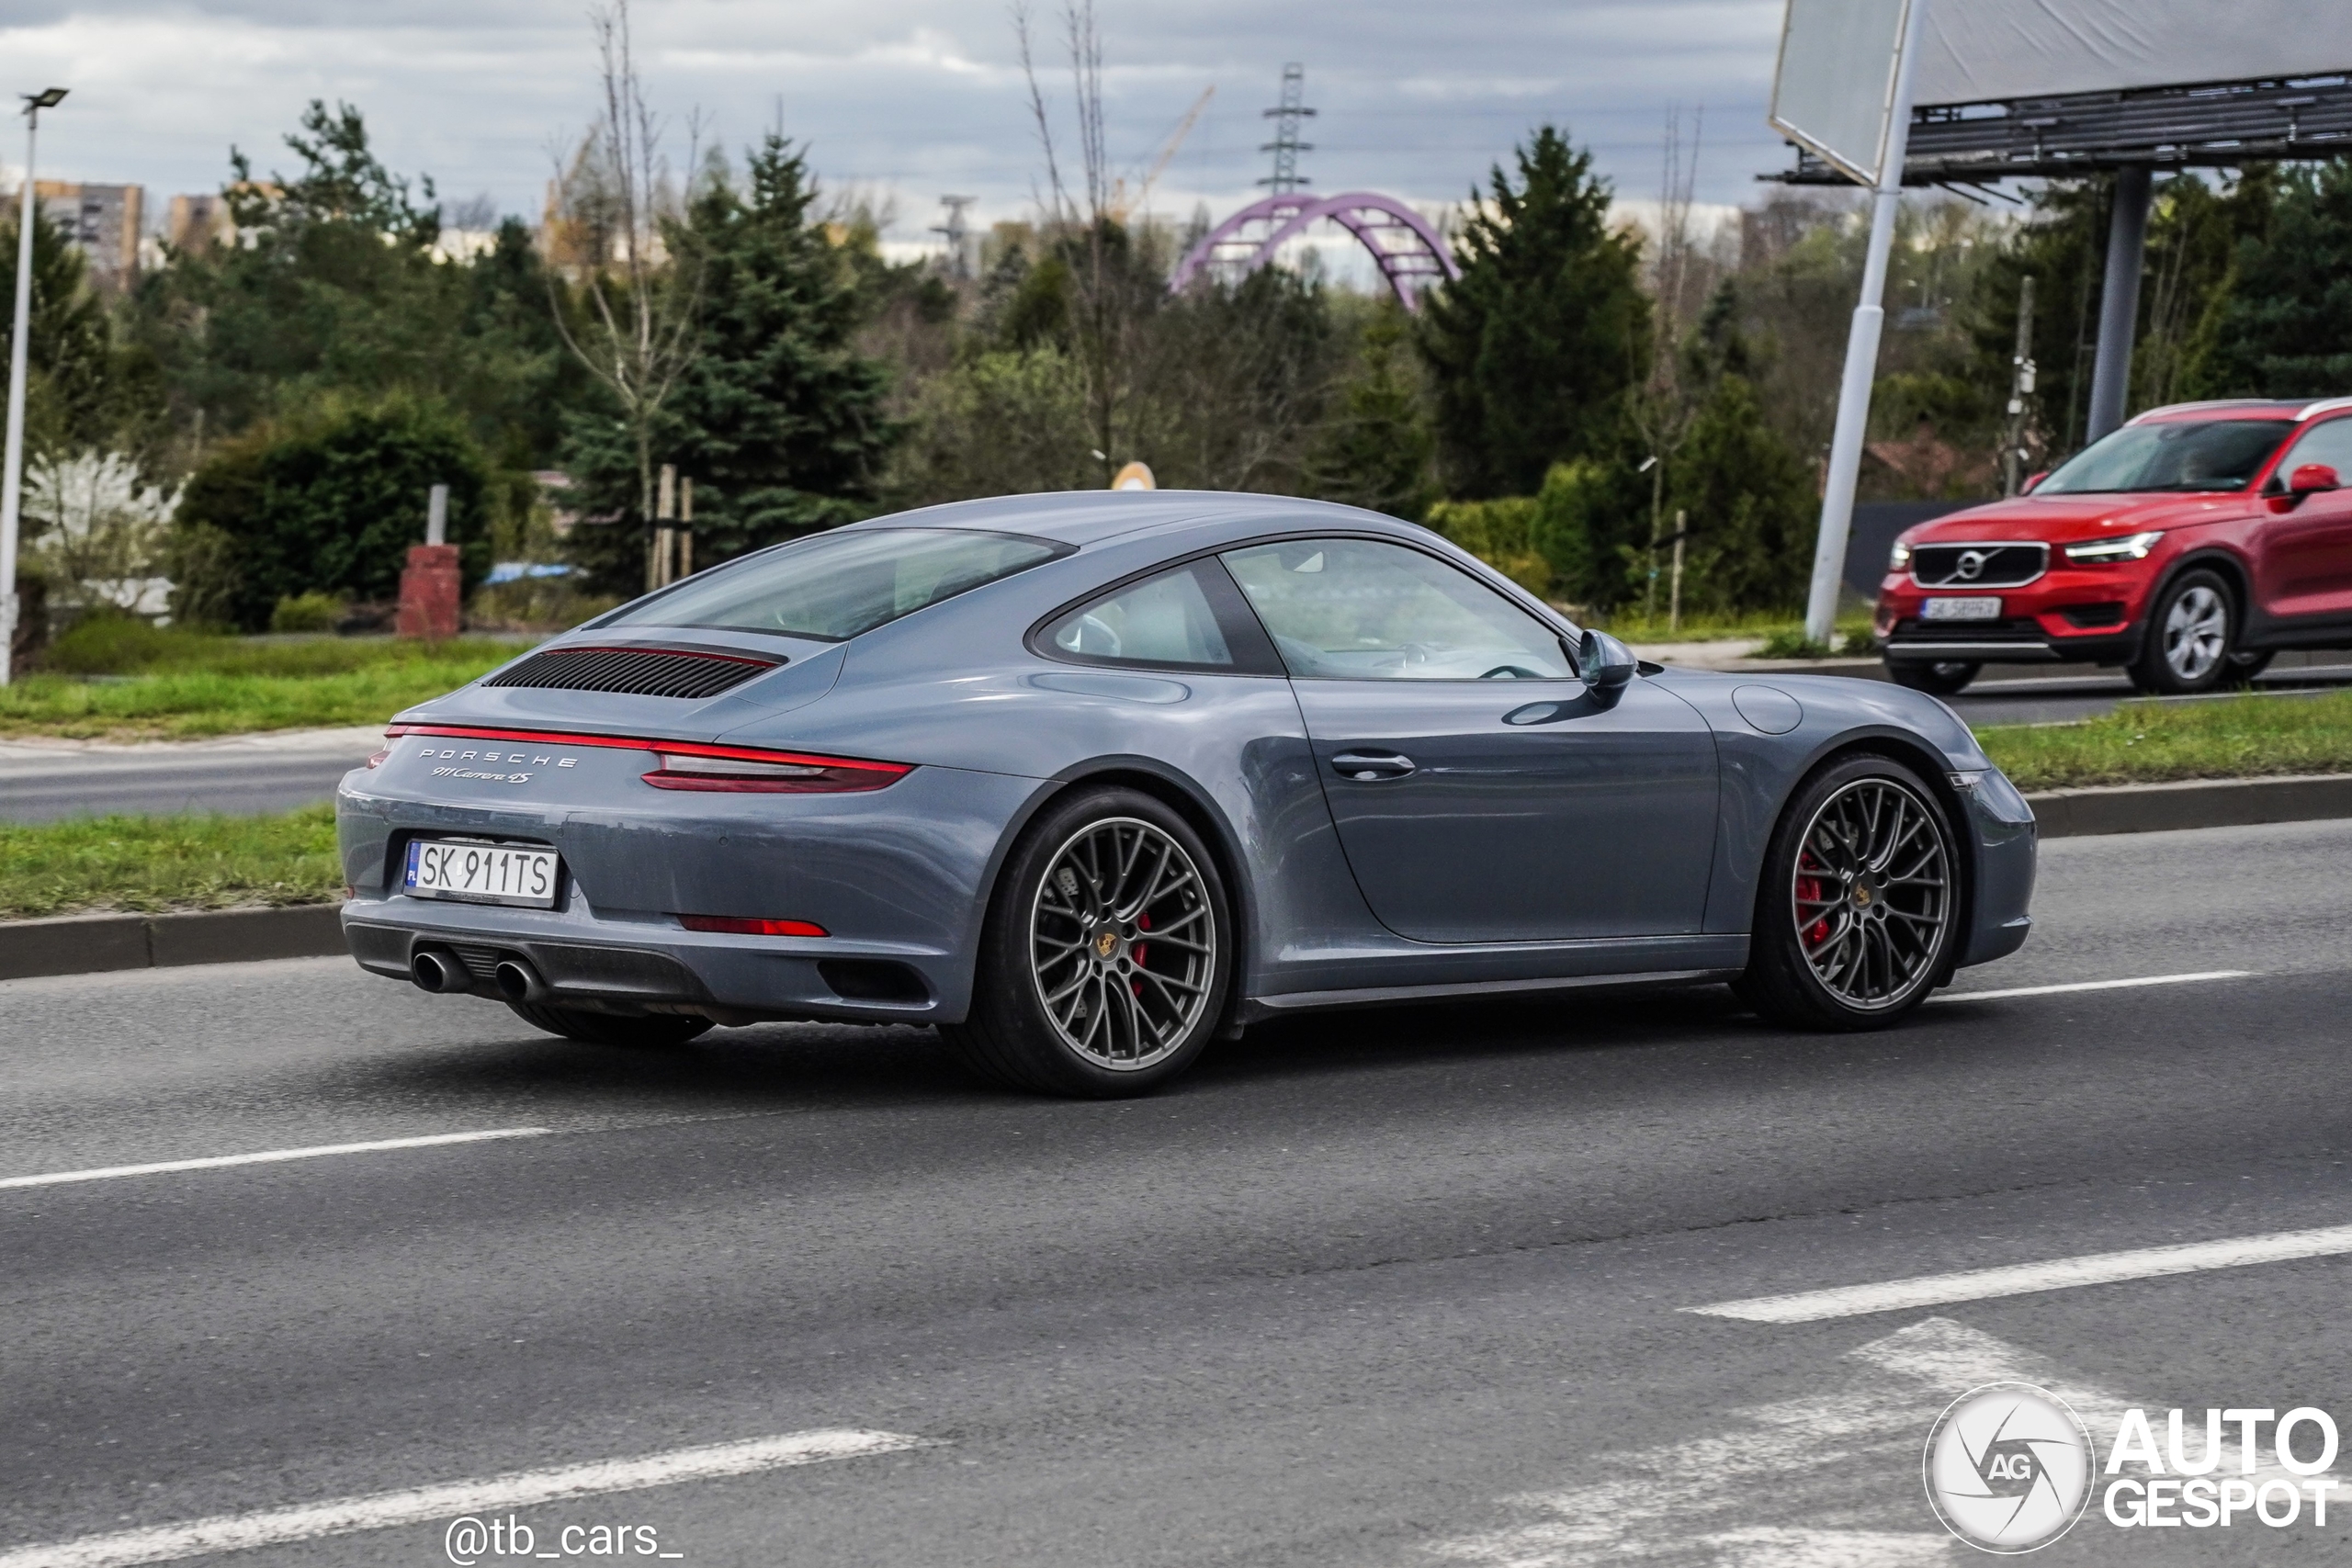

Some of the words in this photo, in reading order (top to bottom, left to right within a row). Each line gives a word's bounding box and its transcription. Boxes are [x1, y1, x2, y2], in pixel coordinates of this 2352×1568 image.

[419, 749, 578, 768] PORSCHE
[453, 767, 506, 781] Carrera
[507, 773, 534, 784] 4S
[407, 870, 417, 881] PL
[423, 847, 456, 887] SK
[464, 851, 548, 895] 911TS
